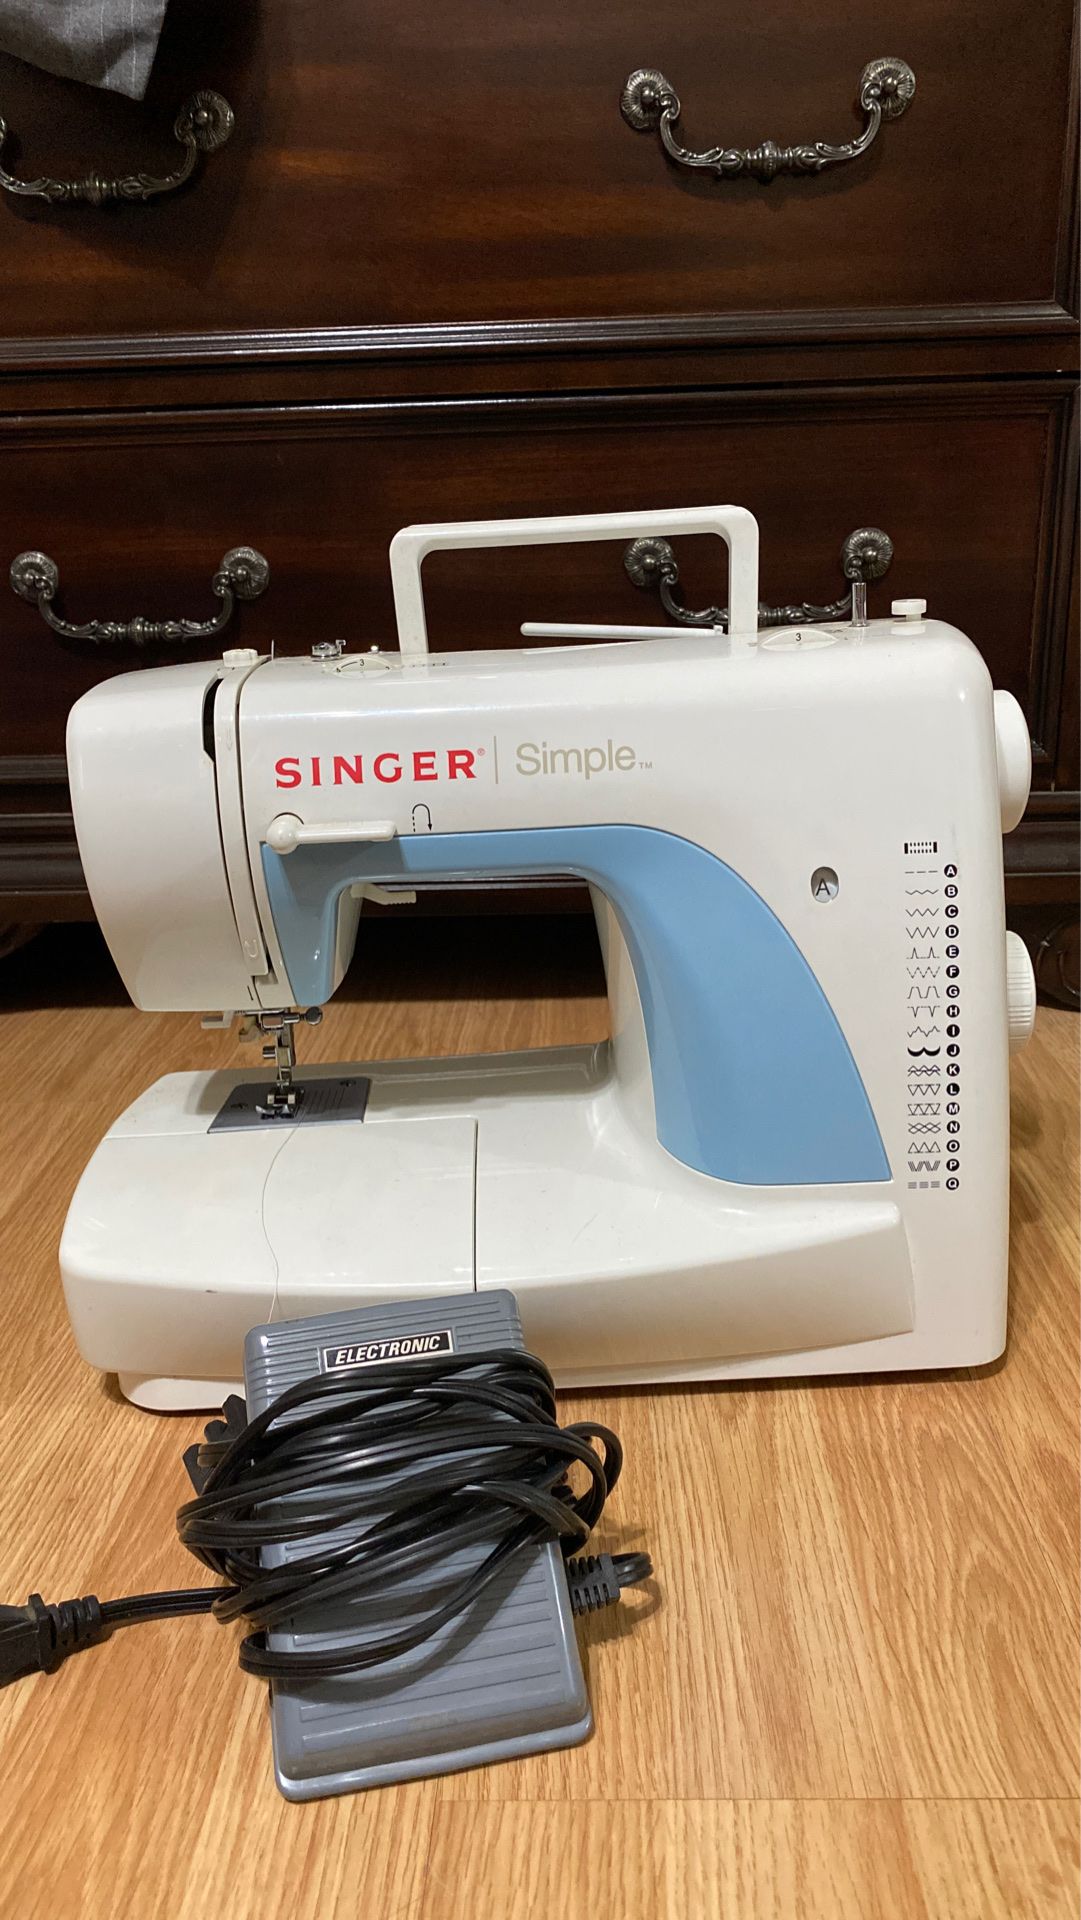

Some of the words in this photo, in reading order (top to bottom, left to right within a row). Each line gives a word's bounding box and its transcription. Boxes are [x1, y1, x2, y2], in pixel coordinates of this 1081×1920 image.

[795, 632, 802, 642] 3
[359, 658, 365, 667] 3
[275, 748, 477, 789] SINGER
[515, 739, 636, 780] Simple
[815, 878, 831, 896] A
[335, 1335, 440, 1365] ELECTRONIC
